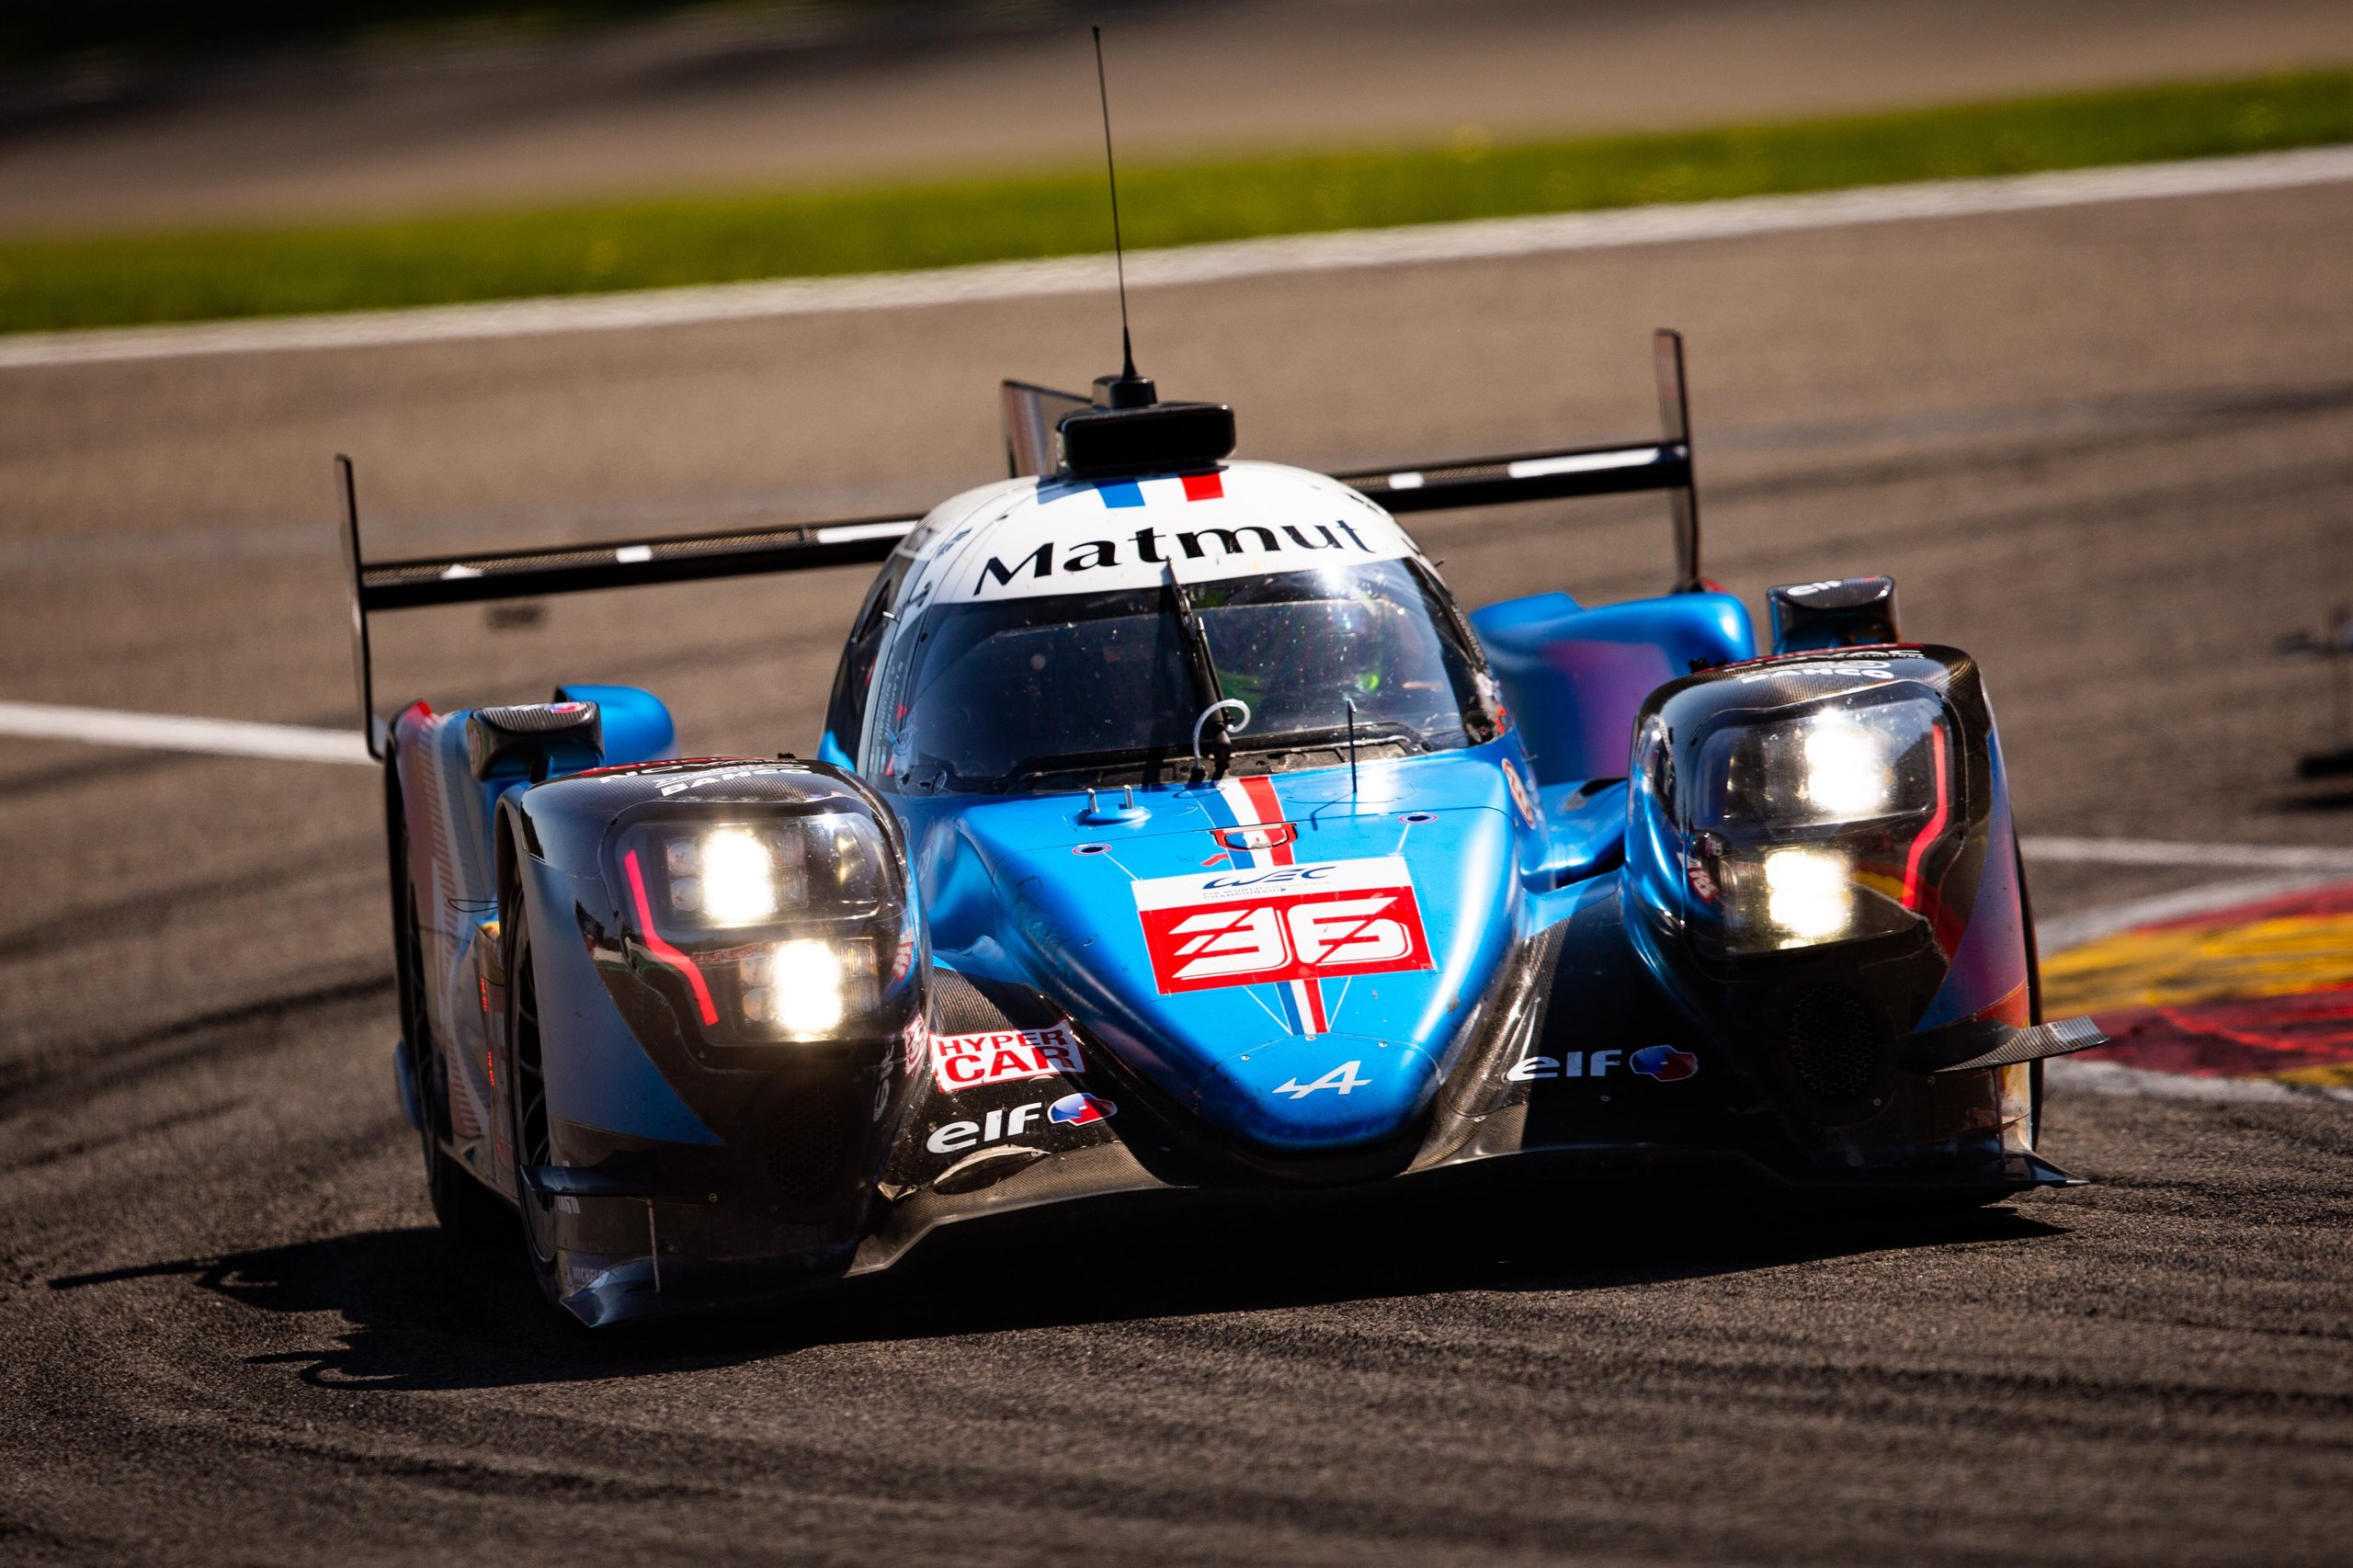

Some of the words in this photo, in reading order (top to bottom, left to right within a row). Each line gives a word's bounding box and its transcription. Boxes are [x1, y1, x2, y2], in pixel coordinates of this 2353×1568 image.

[972, 518, 1377, 597] Matmut
[1202, 866, 1336, 890] WEC
[1167, 896, 1414, 981] 36
[937, 1028, 1069, 1057] HYPER
[944, 1045, 1078, 1083] CAR
[1506, 1049, 1622, 1082] elf
[926, 1102, 1043, 1154] elf
